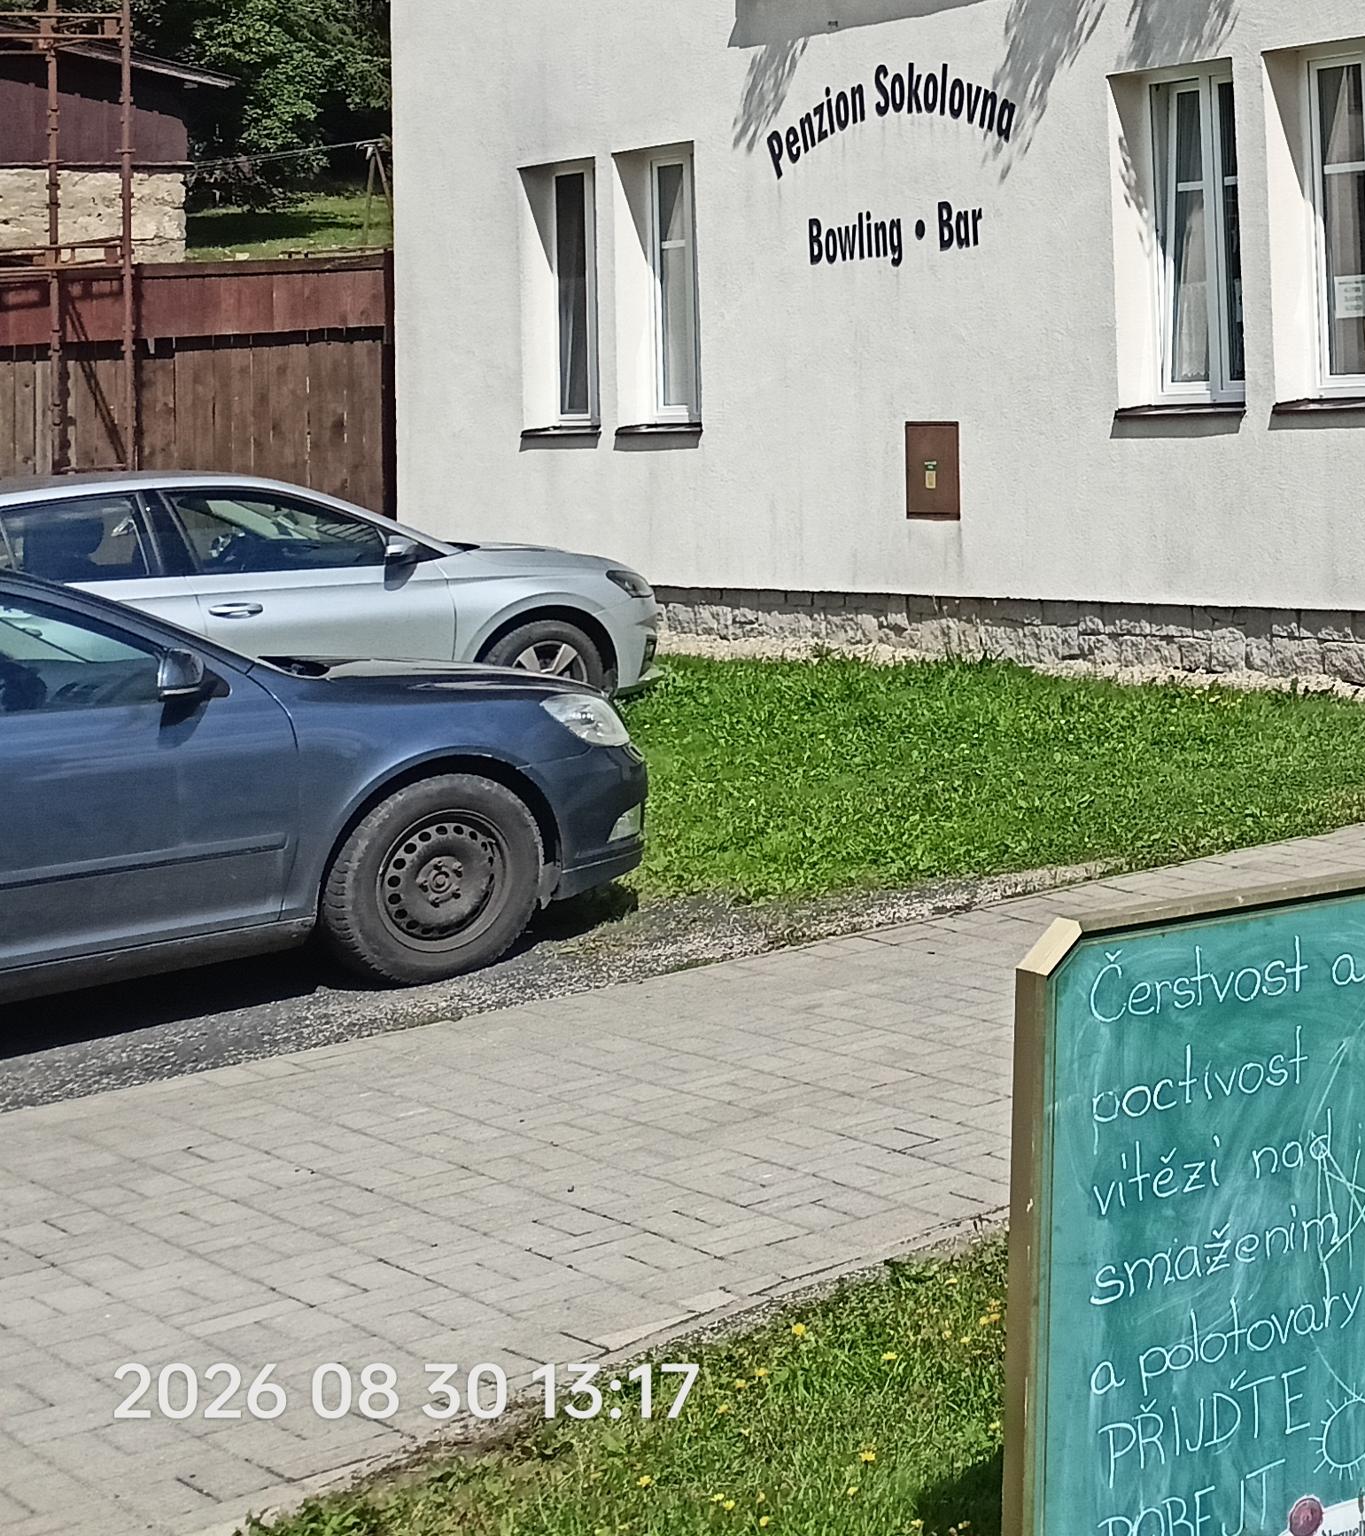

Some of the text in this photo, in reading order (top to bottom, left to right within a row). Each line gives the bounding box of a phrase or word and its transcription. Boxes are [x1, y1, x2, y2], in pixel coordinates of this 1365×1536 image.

[766, 62, 1016, 180] Penzion Sokolovna
[808, 200, 983, 268] Bowling Bar
[1090, 935, 1309, 1023] Čerstvost
[1091, 1024, 1309, 1156] poctivost
[1251, 1107, 1332, 1180] nad
[1090, 1360, 1126, 1395] a
[1097, 1365, 1311, 1490] PŘIJĎTE
